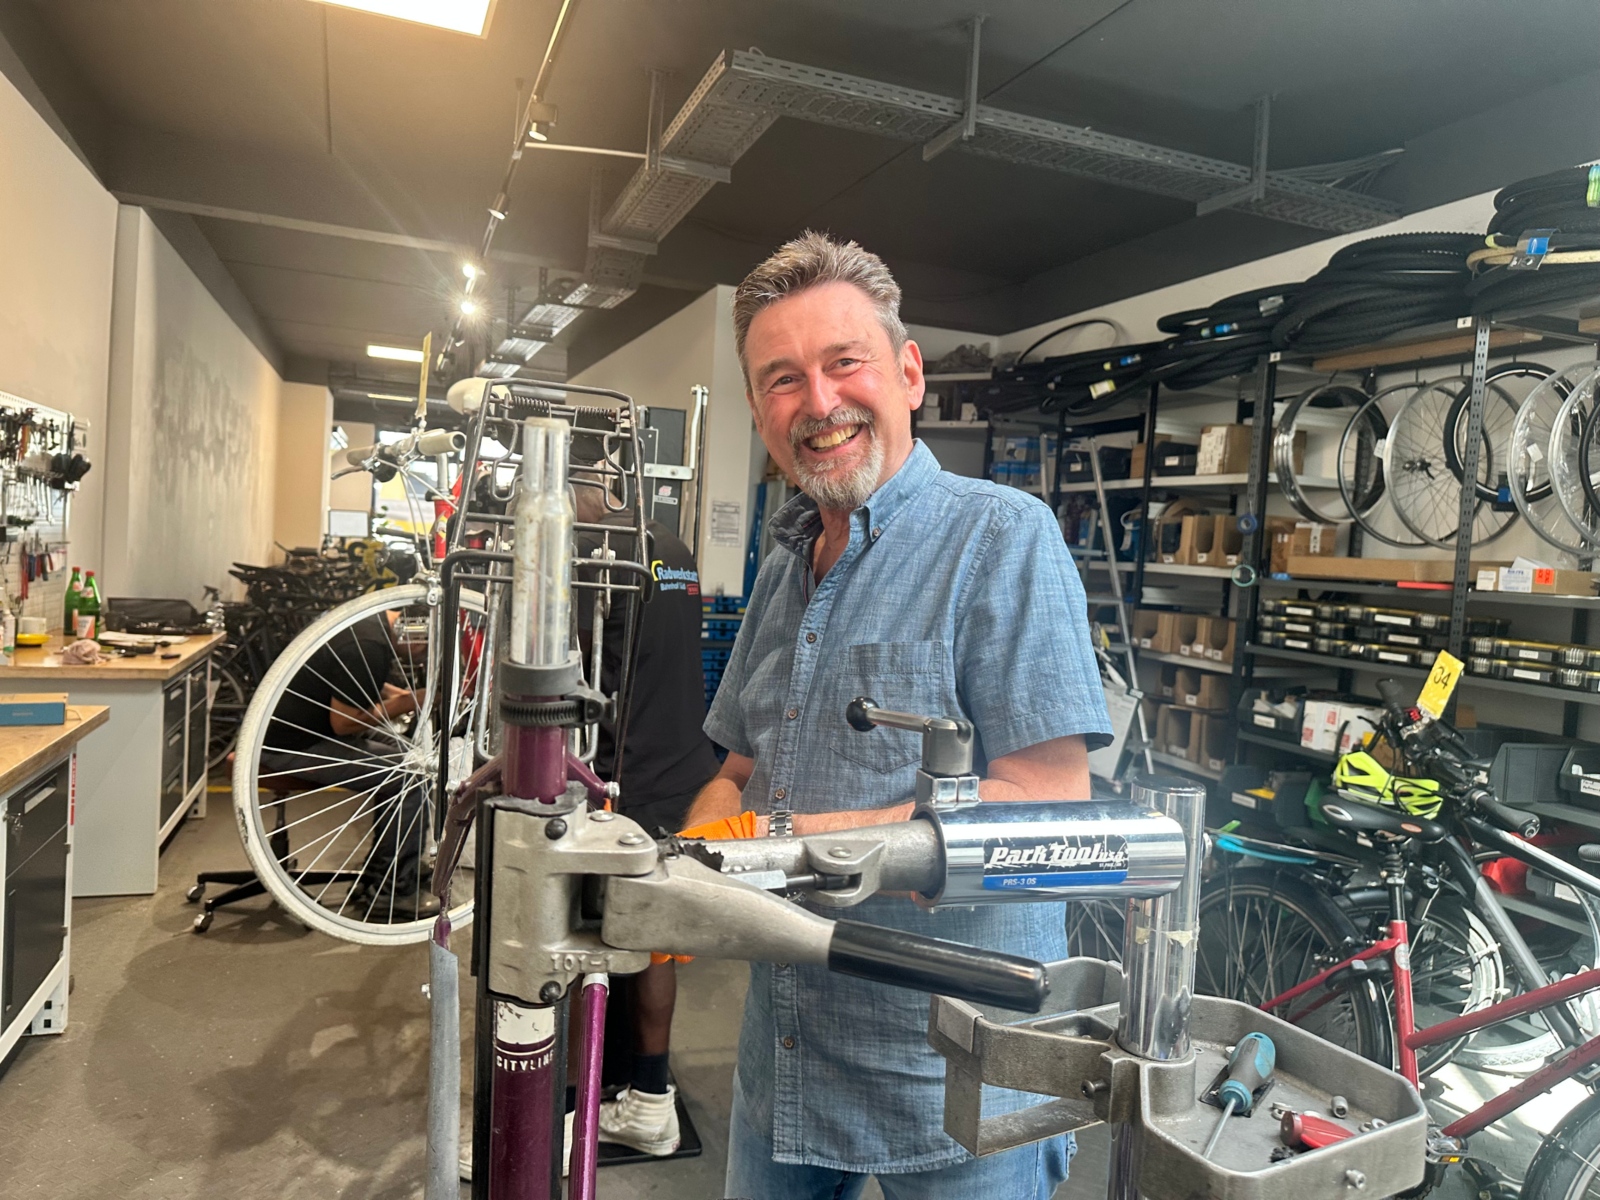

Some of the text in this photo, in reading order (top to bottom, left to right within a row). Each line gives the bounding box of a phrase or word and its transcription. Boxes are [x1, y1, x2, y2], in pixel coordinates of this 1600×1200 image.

[1433, 666, 1451, 690] 04
[988, 844, 1047, 866] Park
[1046, 842, 1101, 865] Tool
[1003, 878, 1025, 886] PRS-3
